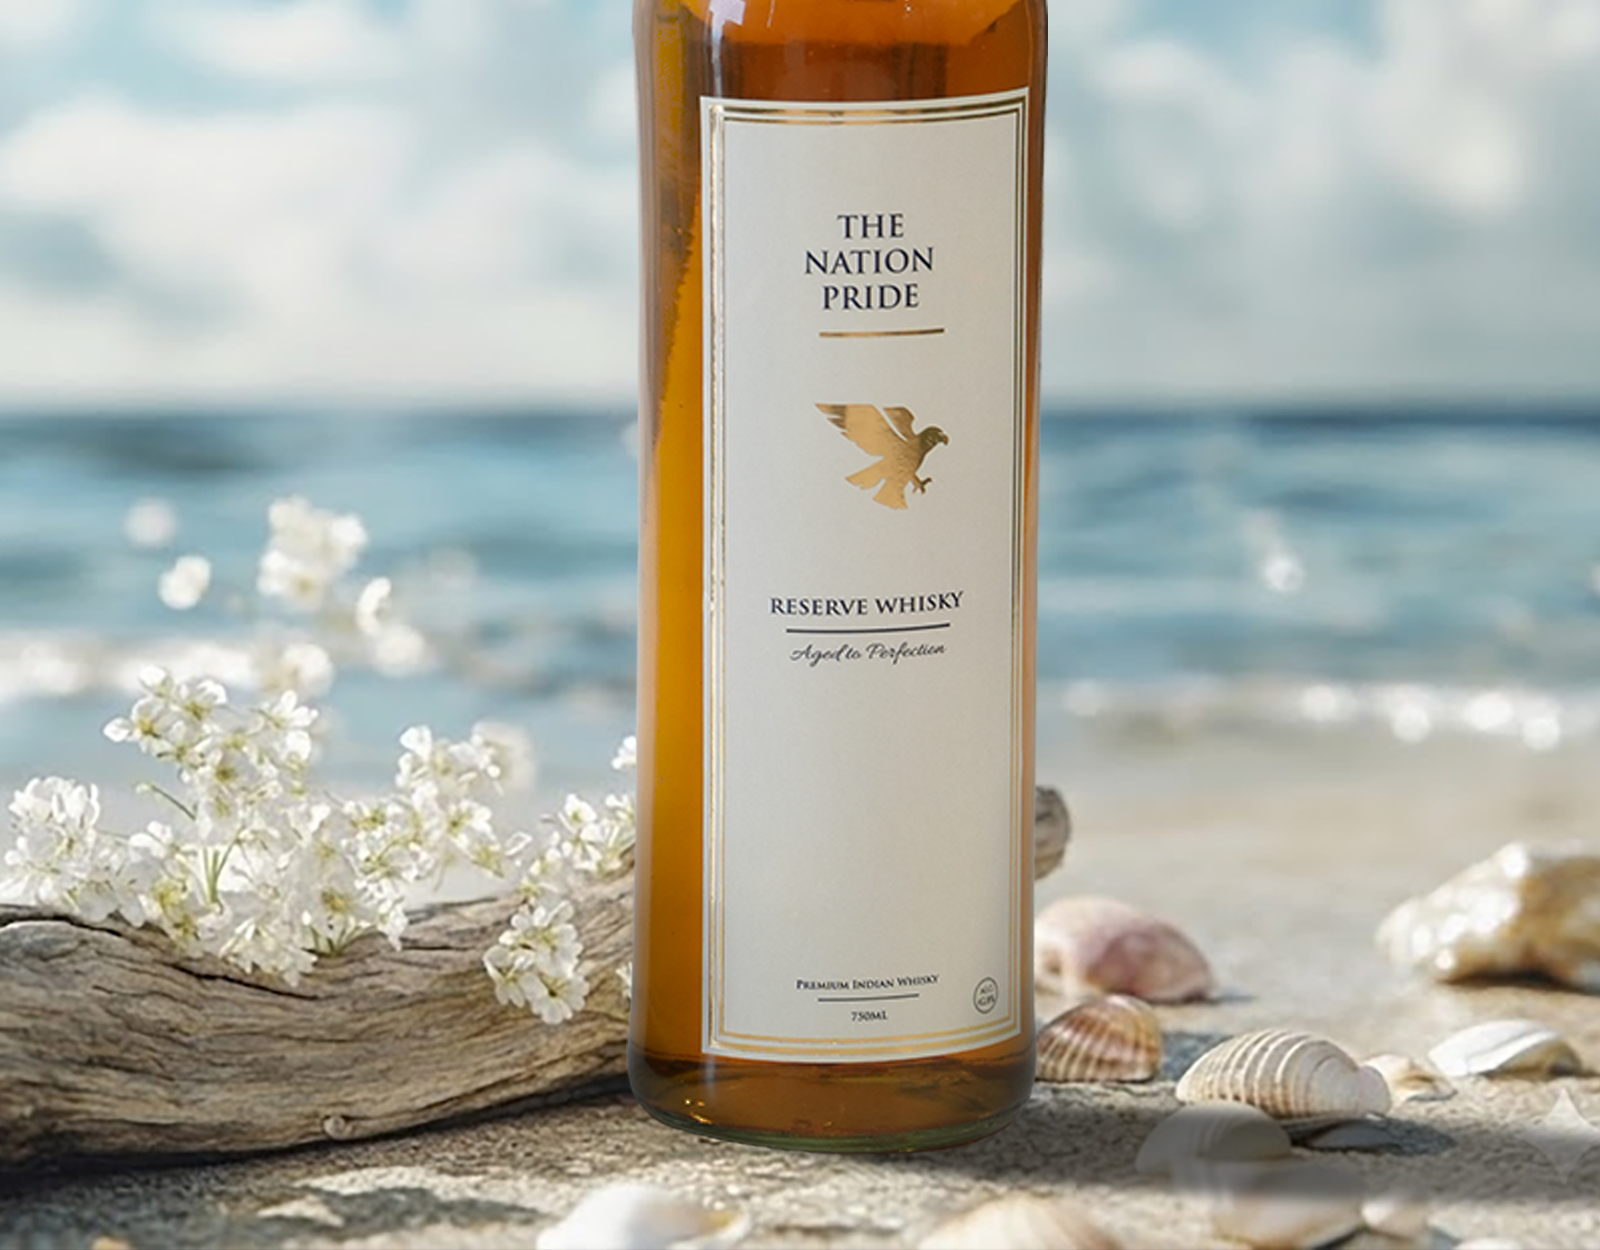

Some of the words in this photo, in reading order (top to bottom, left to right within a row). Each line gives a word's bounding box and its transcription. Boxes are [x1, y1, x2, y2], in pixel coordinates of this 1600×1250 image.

[837, 213, 904, 239] THE
[805, 247, 933, 274] NATION
[822, 283, 919, 310] PRIDE
[770, 597, 868, 615] RESERVE
[875, 590, 964, 613] WHISKY
[790, 644, 848, 667] Aged
[845, 648, 862, 660] to
[865, 642, 946, 665] Perfection
